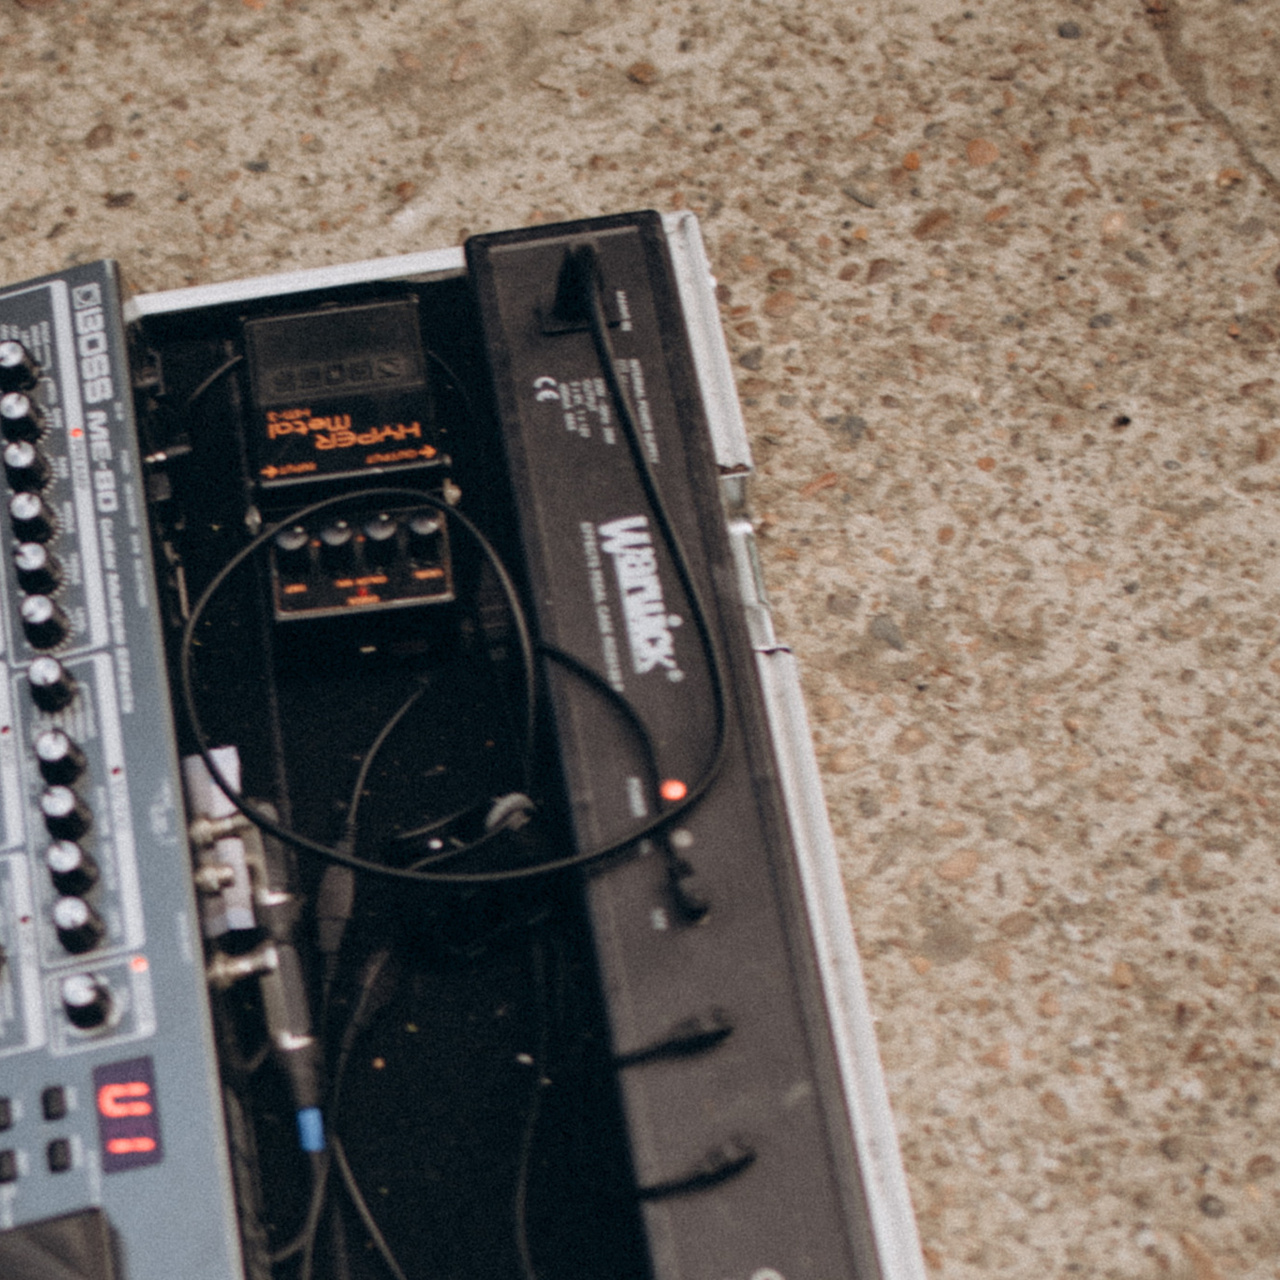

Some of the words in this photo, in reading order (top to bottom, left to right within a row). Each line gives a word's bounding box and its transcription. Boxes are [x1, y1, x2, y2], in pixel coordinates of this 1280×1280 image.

[75, 308, 113, 402] BOSS
[533, 376, 559, 402] CE
[268, 413, 351, 439] Metal
[315, 421, 421, 450] HYPER
[86, 410, 118, 512] ME-80
[366, 449, 418, 463] OUTPUT
[99, 518, 116, 569] Guitar
[599, 515, 682, 673] Warwick
[116, 647, 133, 712] Effects
